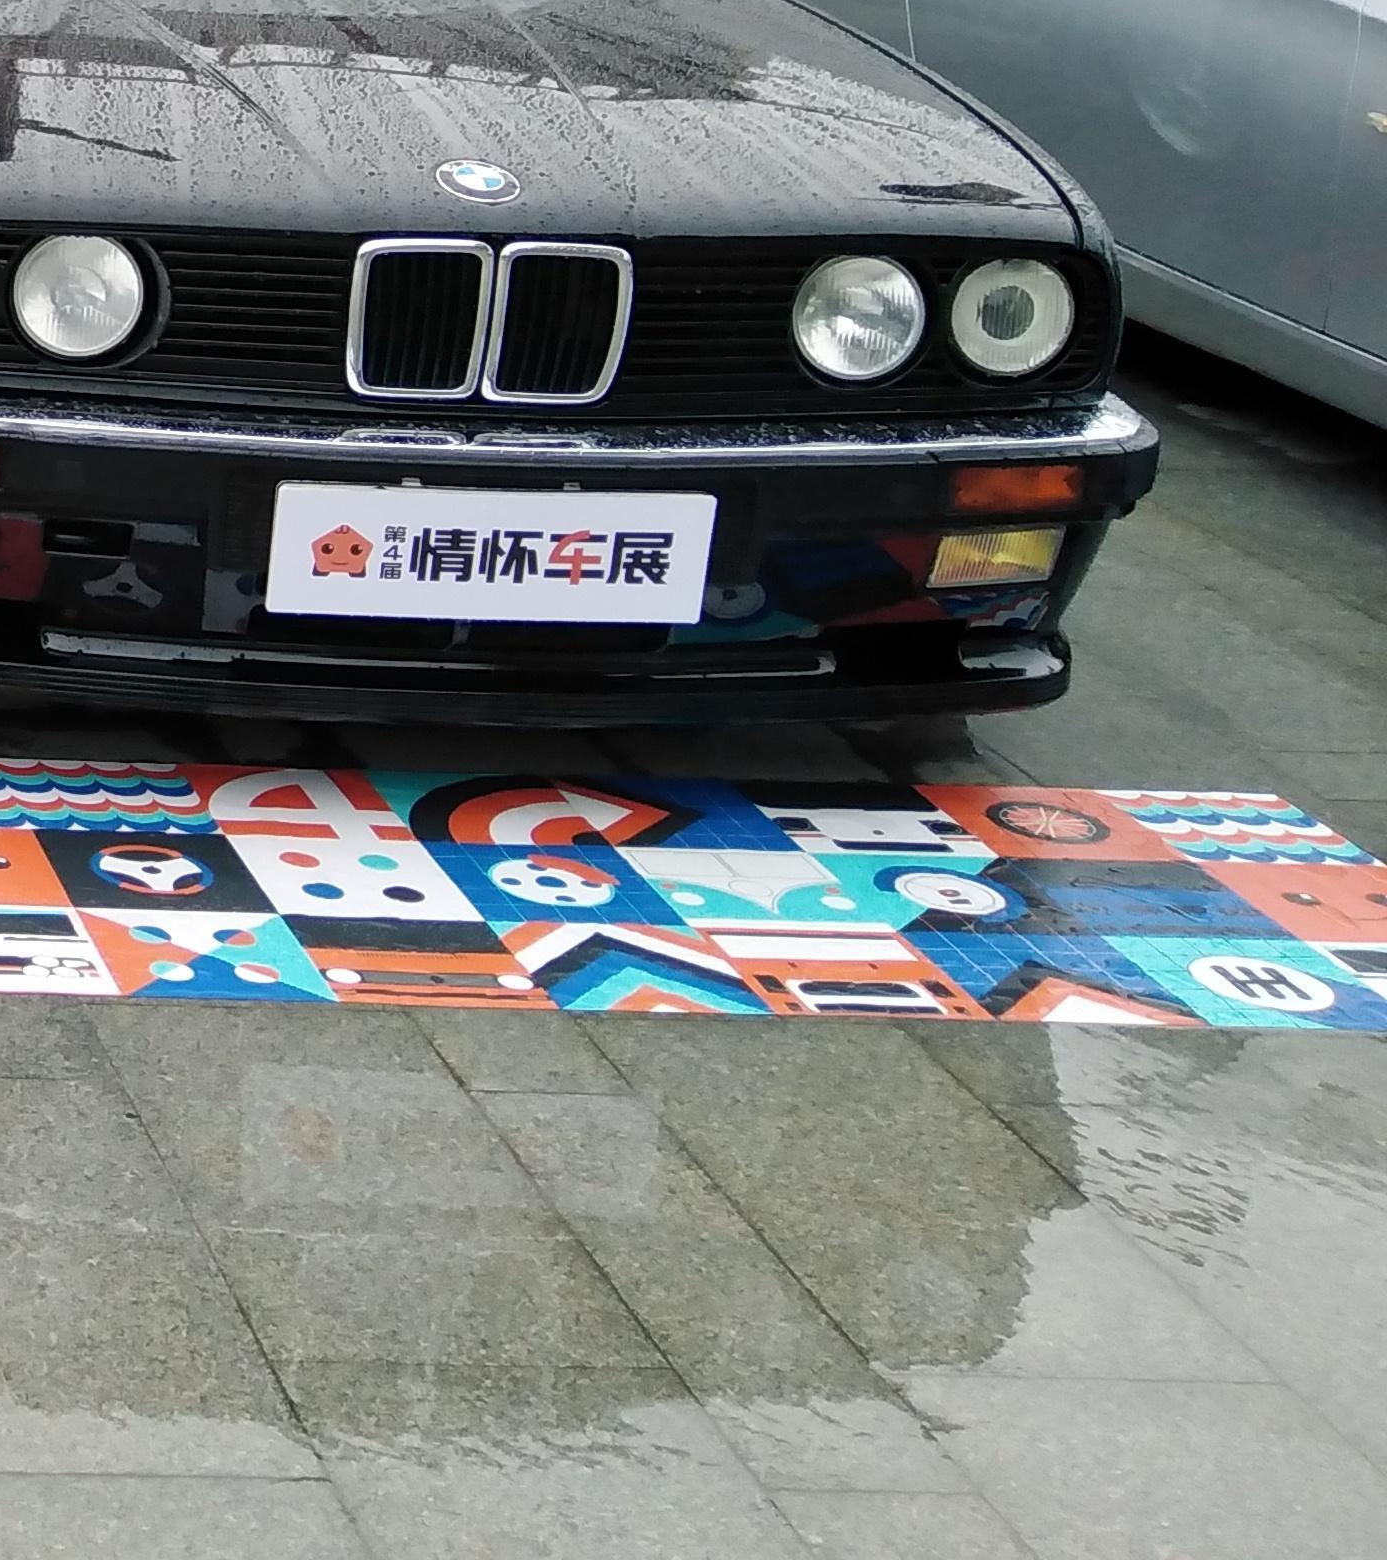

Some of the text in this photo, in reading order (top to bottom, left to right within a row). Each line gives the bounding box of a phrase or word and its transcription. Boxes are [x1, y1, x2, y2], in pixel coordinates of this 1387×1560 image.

[379, 525, 408, 581] 第4届
[409, 527, 675, 586] 情怀车展
